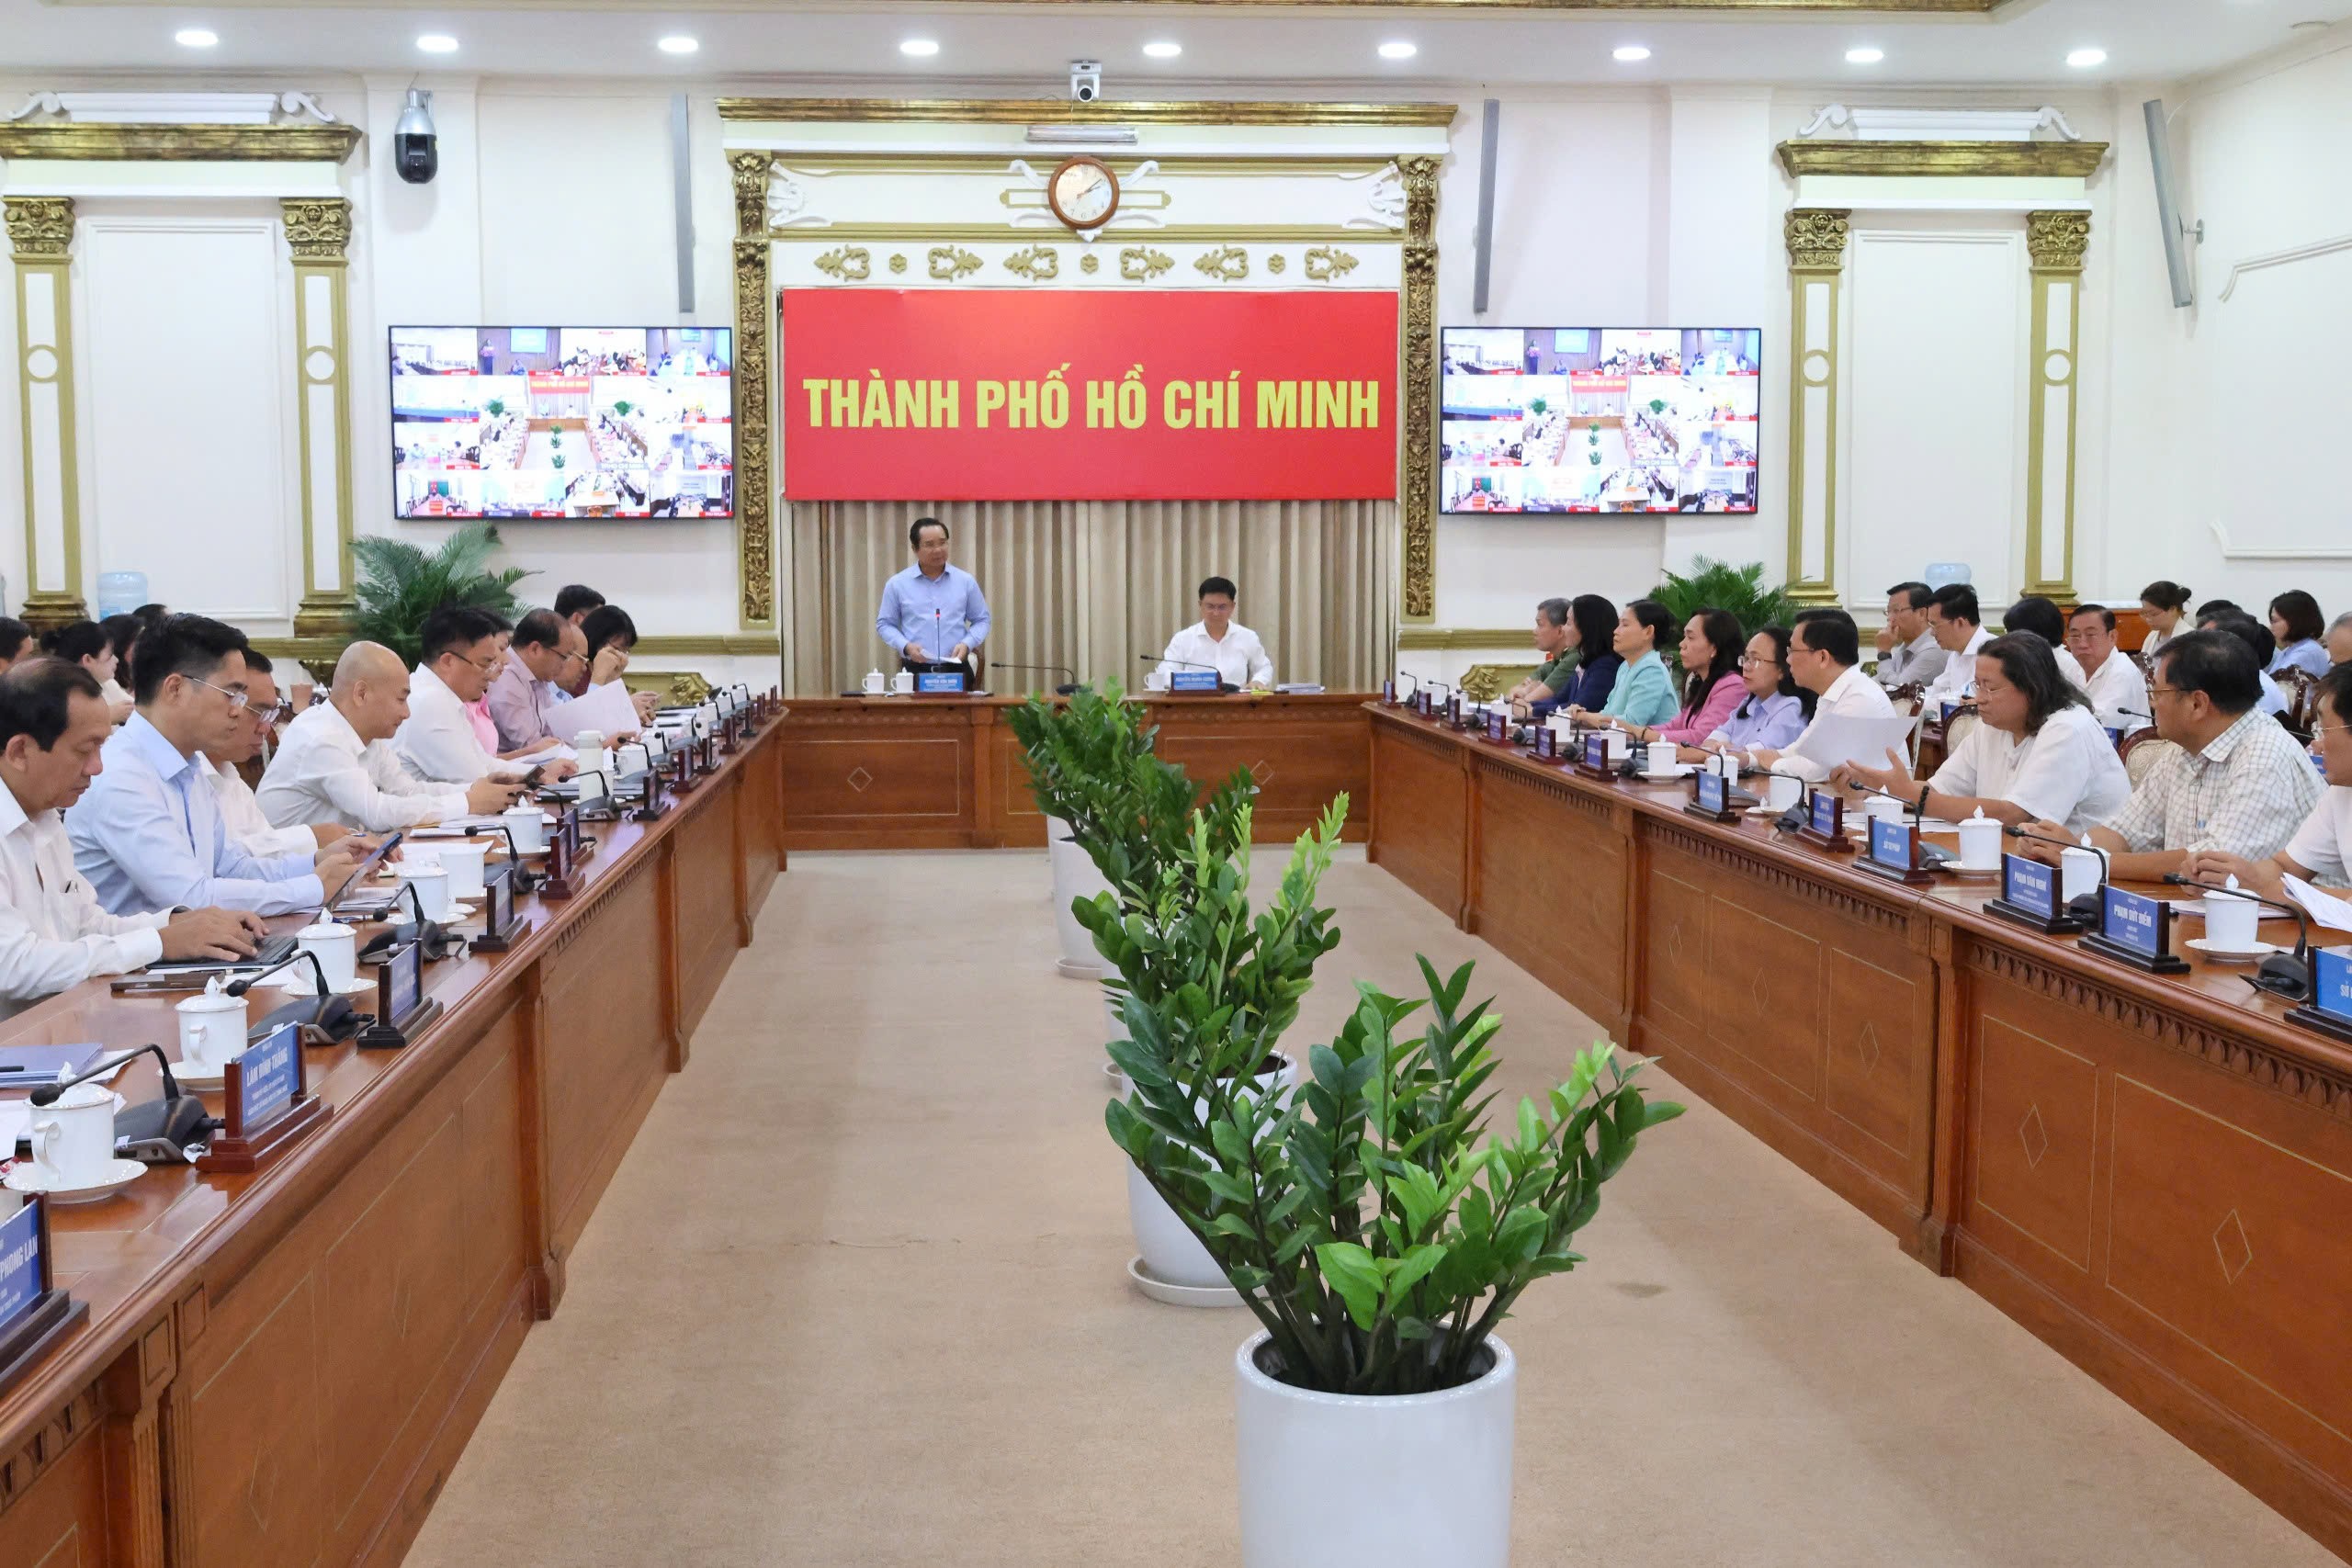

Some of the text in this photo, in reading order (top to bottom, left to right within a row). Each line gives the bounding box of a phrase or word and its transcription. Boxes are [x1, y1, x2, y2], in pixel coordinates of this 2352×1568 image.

[803, 363, 1378, 429] THÀNH PHỐ HỒ CHÍ MINH
[0, 1235, 39, 1282] PHONG LAN
